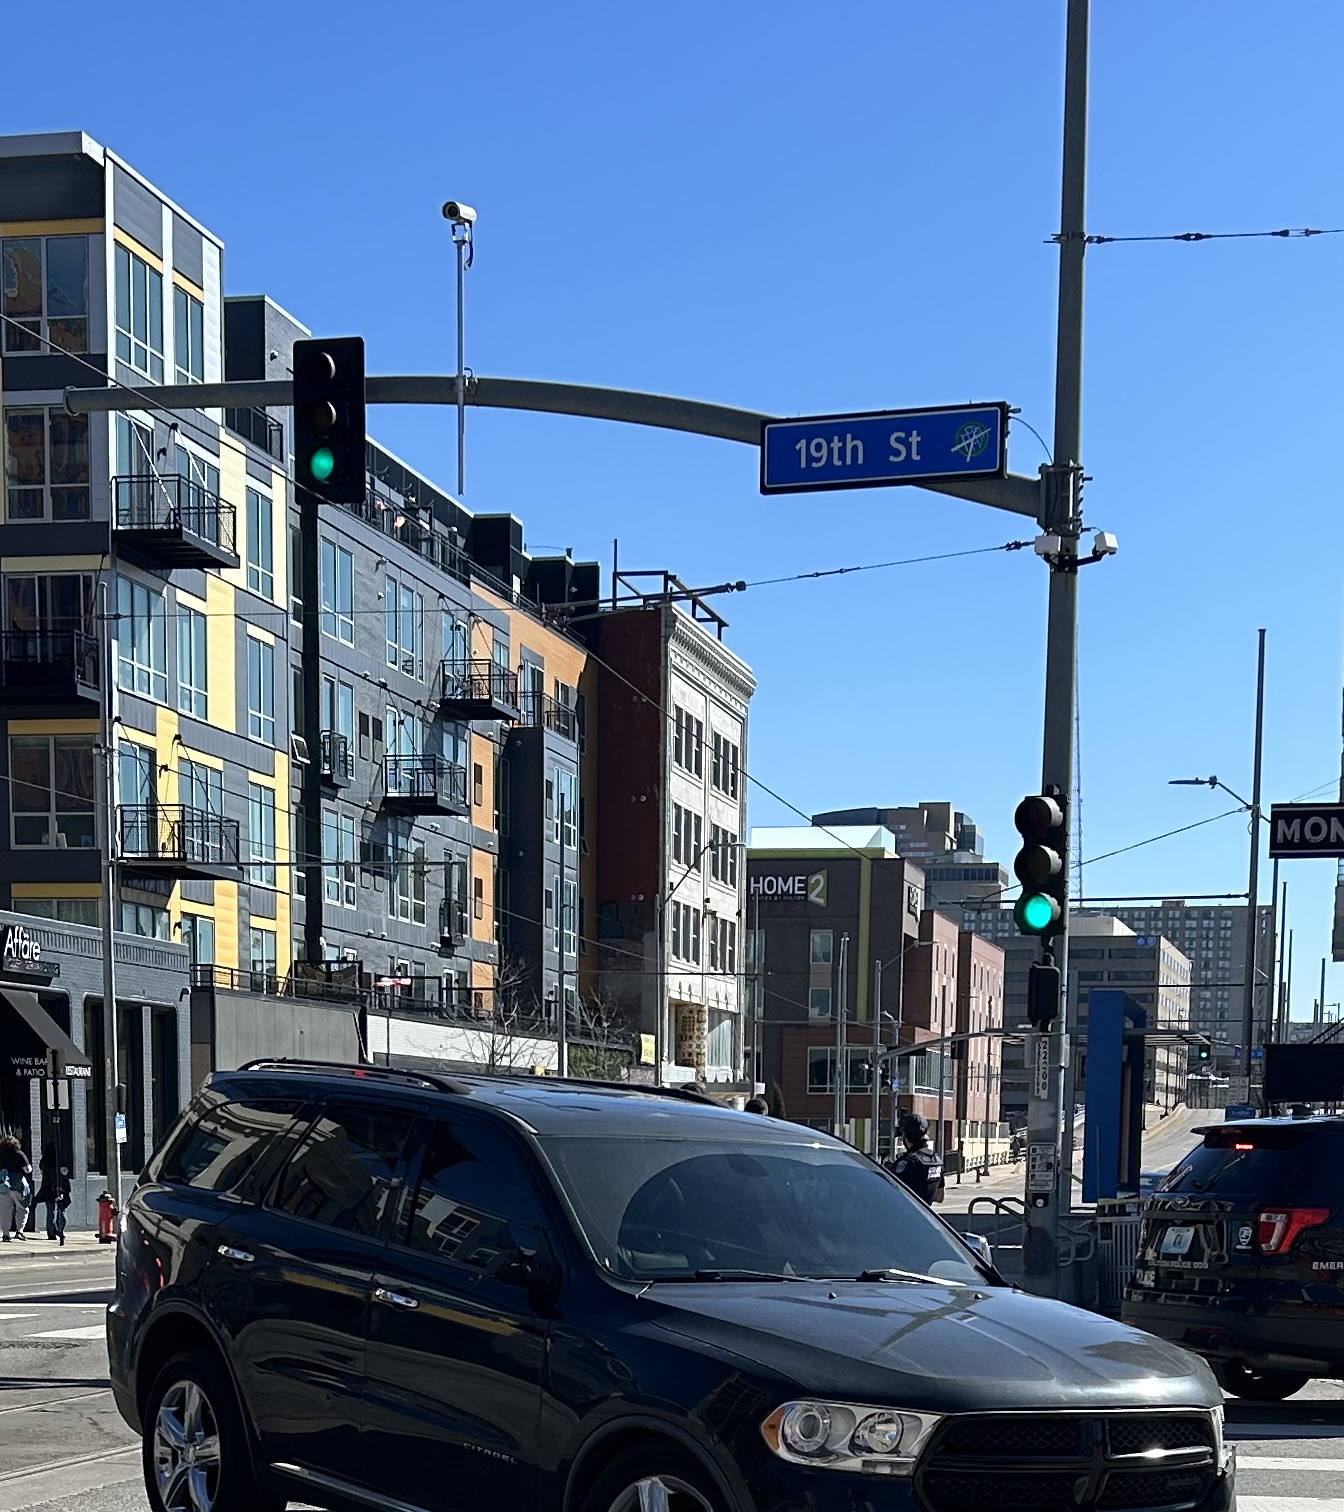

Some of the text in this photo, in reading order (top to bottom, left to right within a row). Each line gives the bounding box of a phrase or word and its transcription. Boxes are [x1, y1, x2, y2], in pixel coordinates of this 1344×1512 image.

[795, 431, 922, 469] 19th St
[4, 926, 41, 961] Affäre
[11, 1056, 33, 1065] WINE
[24, 1068, 46, 1077] PATIO
[463, 1442, 519, 1464] CITADEL
